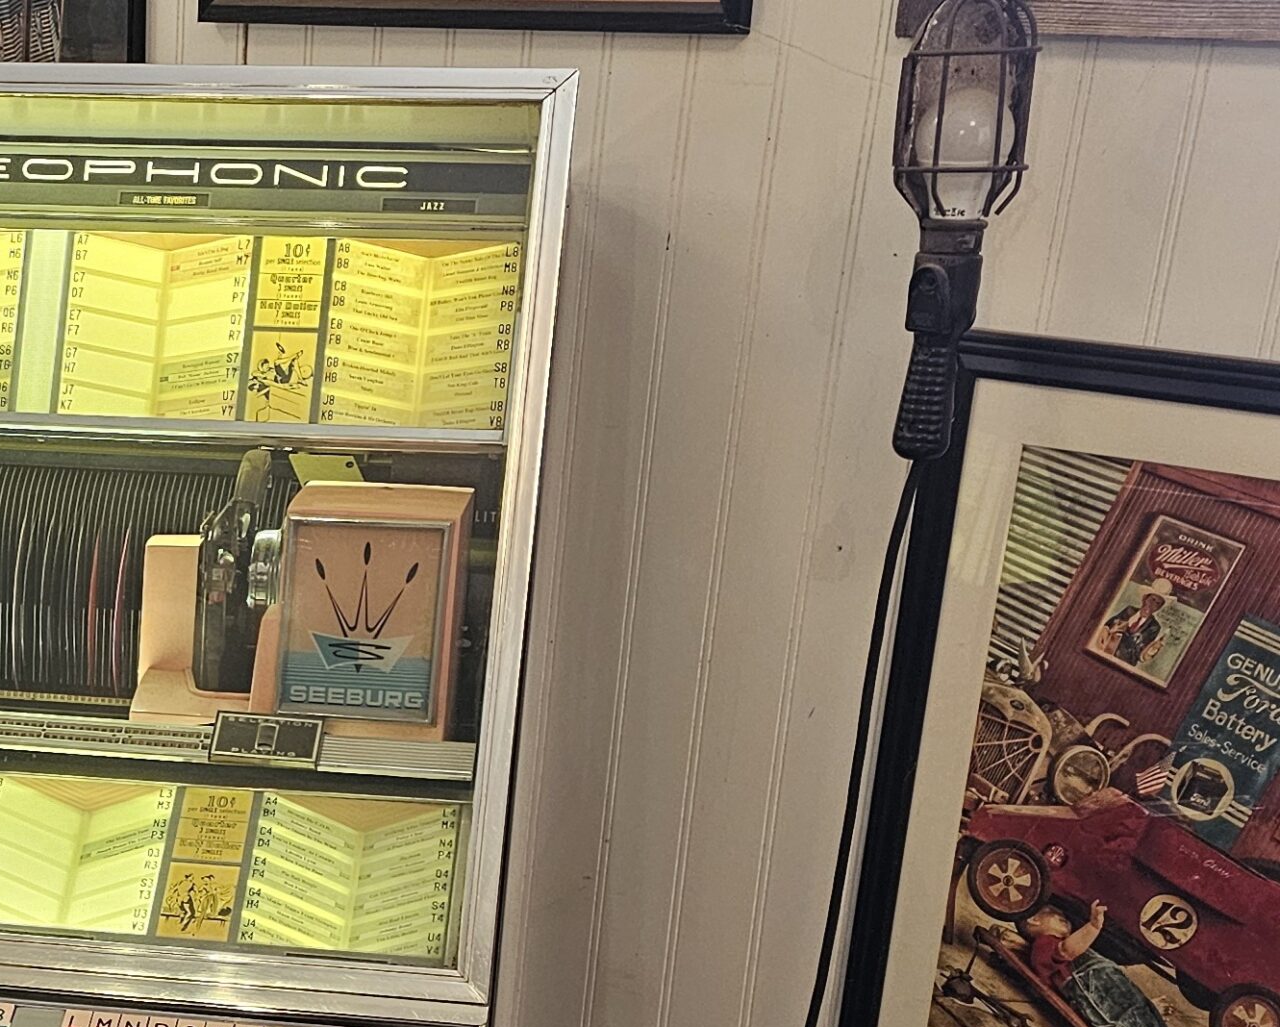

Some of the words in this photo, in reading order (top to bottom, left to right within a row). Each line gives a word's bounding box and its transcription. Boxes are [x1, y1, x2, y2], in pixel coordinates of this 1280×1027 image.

[420, 201, 445, 211] JAZZ
[284, 243, 311, 258] 10¢
[338, 243, 350, 253] A8
[505, 246, 519, 257] L8
[336, 258, 349, 268] B8
[334, 280, 346, 291] C8
[502, 285, 515, 295] N8
[332, 295, 345, 306] D8
[500, 300, 514, 311] P8
[330, 318, 342, 330] E8
[498, 324, 511, 335] Q8
[329, 334, 341, 344] F8
[496, 339, 510, 350] R8
[327, 357, 338, 367] G8
[494, 362, 507, 373] S8
[493, 377, 505, 388] T8
[323, 395, 335, 405] J8
[490, 401, 503, 411] U8
[321, 410, 333, 420] K8
[489, 416, 502, 427] V8
[1178, 534, 1214, 552] DRINK
[1156, 544, 1215, 570] Miller
[1154, 567, 1198, 591] BEVERAGES
[1227, 652, 1280, 687] GENU
[289, 685, 424, 709] SEEBURG
[228, 716, 313, 728] SELECTION
[1202, 698, 1278, 751] Battery
[231, 747, 296, 757] PLAYING
[265, 797, 277, 806] A4
[263, 808, 275, 817] B4
[260, 827, 272, 836] C4
[258, 838, 270, 848] D4
[254, 857, 266, 866] E4
[252, 869, 264, 878] F4
[249, 887, 261, 897] G4
[246, 899, 259, 909] H4
[243, 918, 256, 928] J4
[1141, 901, 1194, 946] 12
[240, 931, 253, 940] K4
